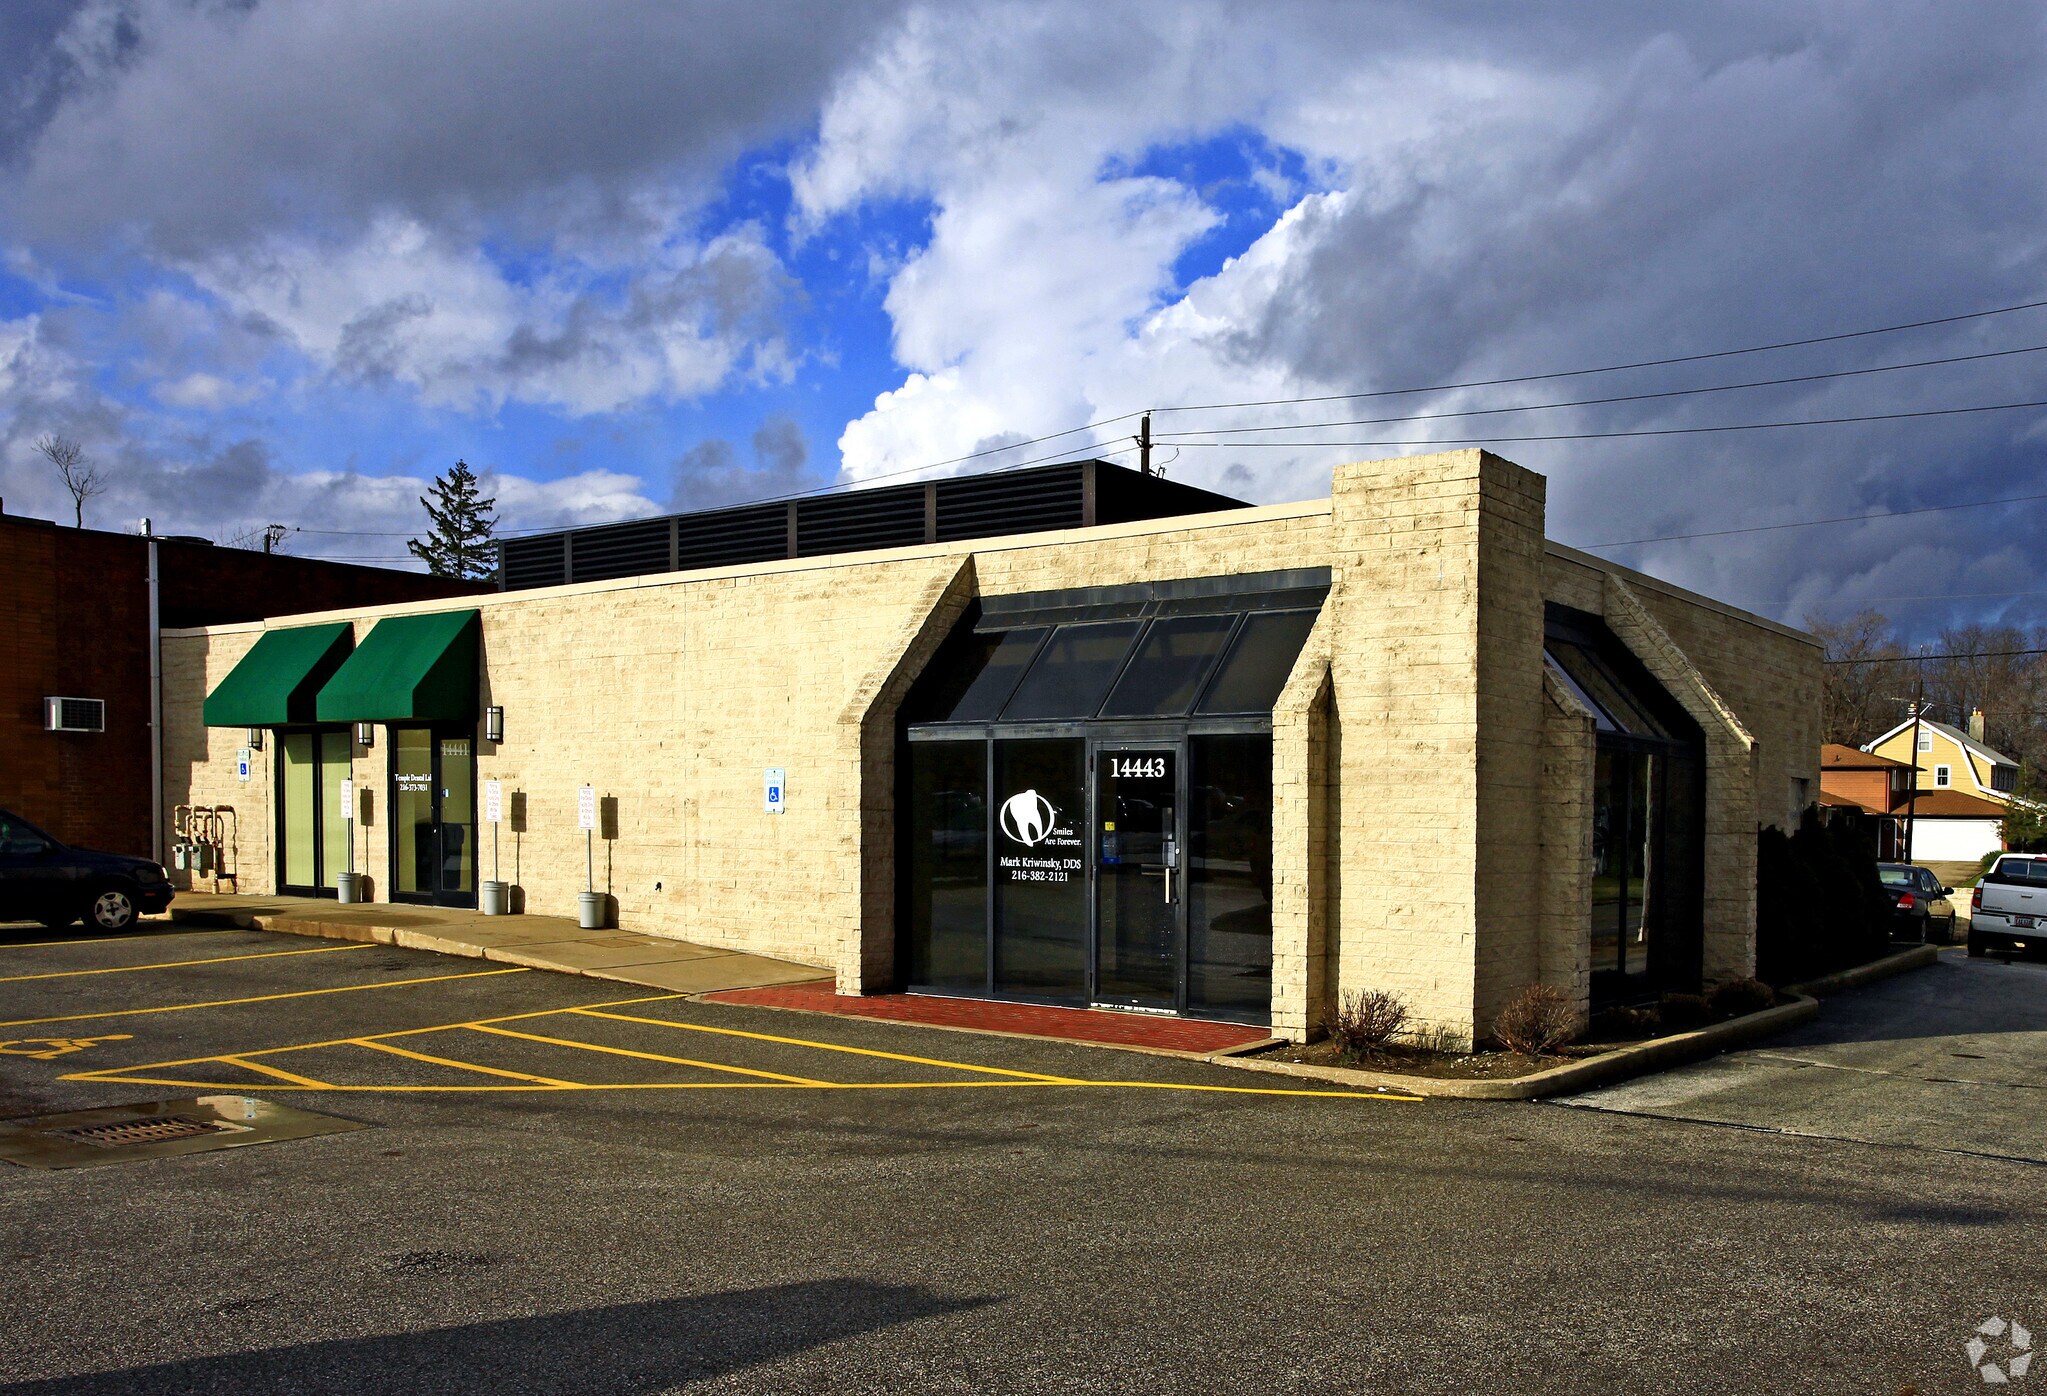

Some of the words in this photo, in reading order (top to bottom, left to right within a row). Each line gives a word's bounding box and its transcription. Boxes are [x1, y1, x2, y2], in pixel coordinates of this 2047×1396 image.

[1110, 758, 1165, 778] 14443
[1052, 827, 1073, 836] Smiles
[1044, 838, 1056, 846] Are
[1057, 838, 1082, 846] Forever.
[1000, 856, 1021, 867] Mark
[1022, 857, 1062, 871] Kriwinsky,
[1063, 859, 1082, 869] DDS
[1011, 870, 1068, 882] 216-382-2121
